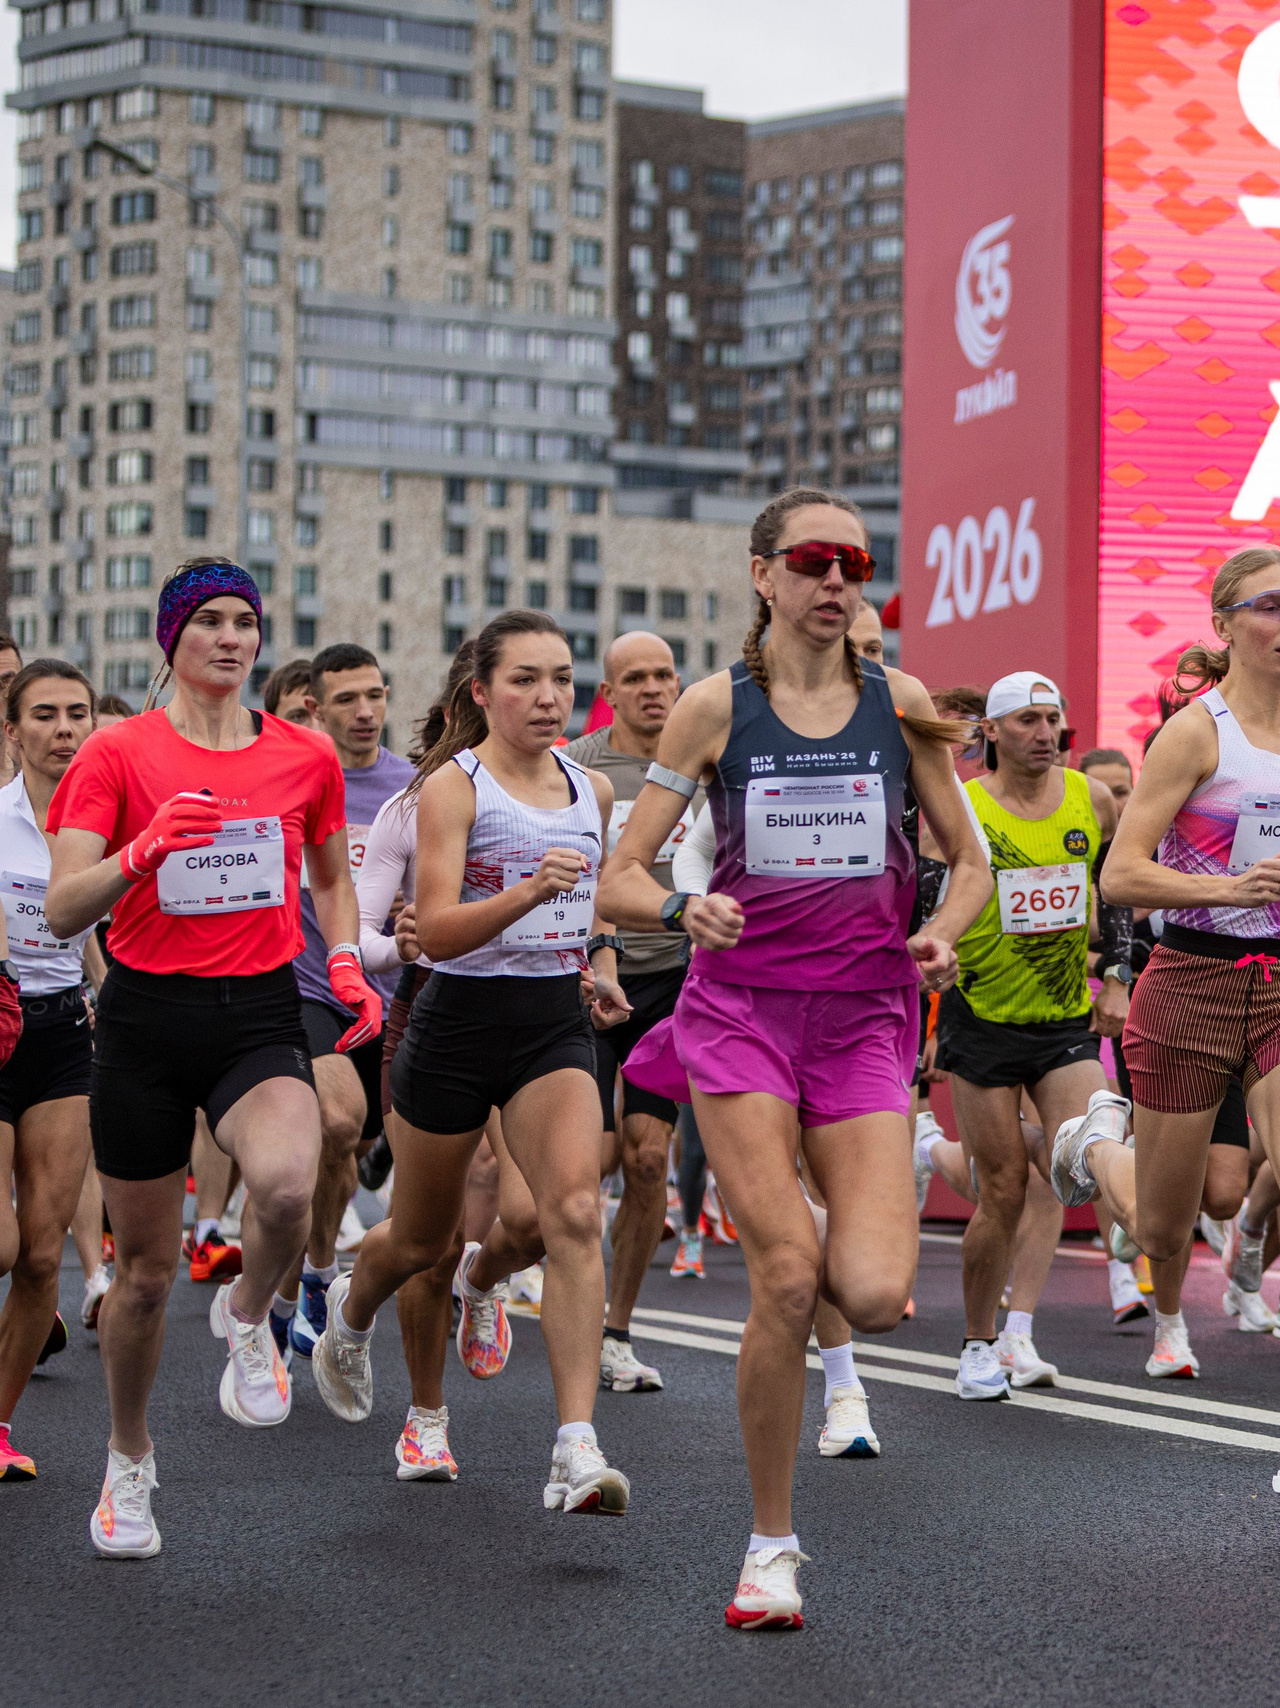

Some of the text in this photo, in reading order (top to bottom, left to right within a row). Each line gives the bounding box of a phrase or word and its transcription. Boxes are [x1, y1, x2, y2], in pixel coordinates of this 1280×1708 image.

[925, 497, 1043, 628] 2026
[750, 755, 774, 764] BIV
[751, 763, 775, 773] IUM
[219, 798, 248, 806] OAX
[766, 811, 866, 828] БЫШКИНА
[812, 834, 821, 845] 3
[185, 852, 258, 870] СИЗОВА
[220, 874, 228, 885] 5
[1010, 884, 1080, 914] 2667
[554, 911, 565, 921] 19
[37, 923, 50, 933] 25
